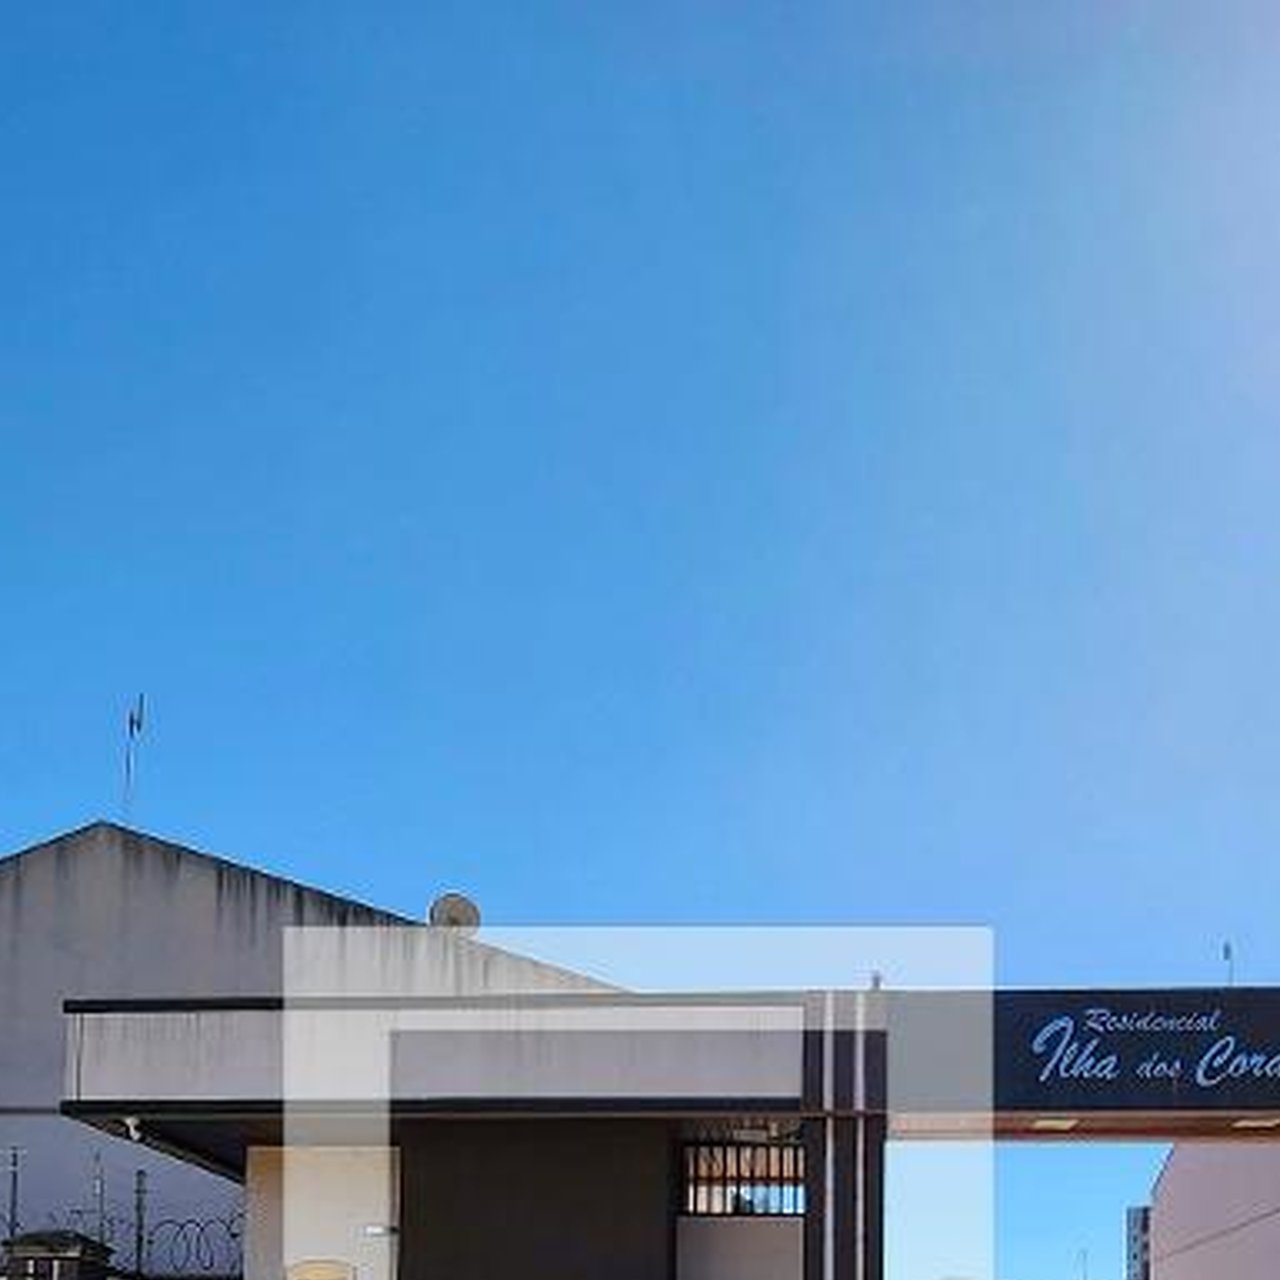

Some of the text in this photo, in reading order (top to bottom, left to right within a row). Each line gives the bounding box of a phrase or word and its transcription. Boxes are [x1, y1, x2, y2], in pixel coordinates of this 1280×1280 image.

[1082, 1008, 1220, 1033] Residencial
[1032, 1016, 1121, 1083] Ilha
[1135, 1050, 1181, 1078] dos
